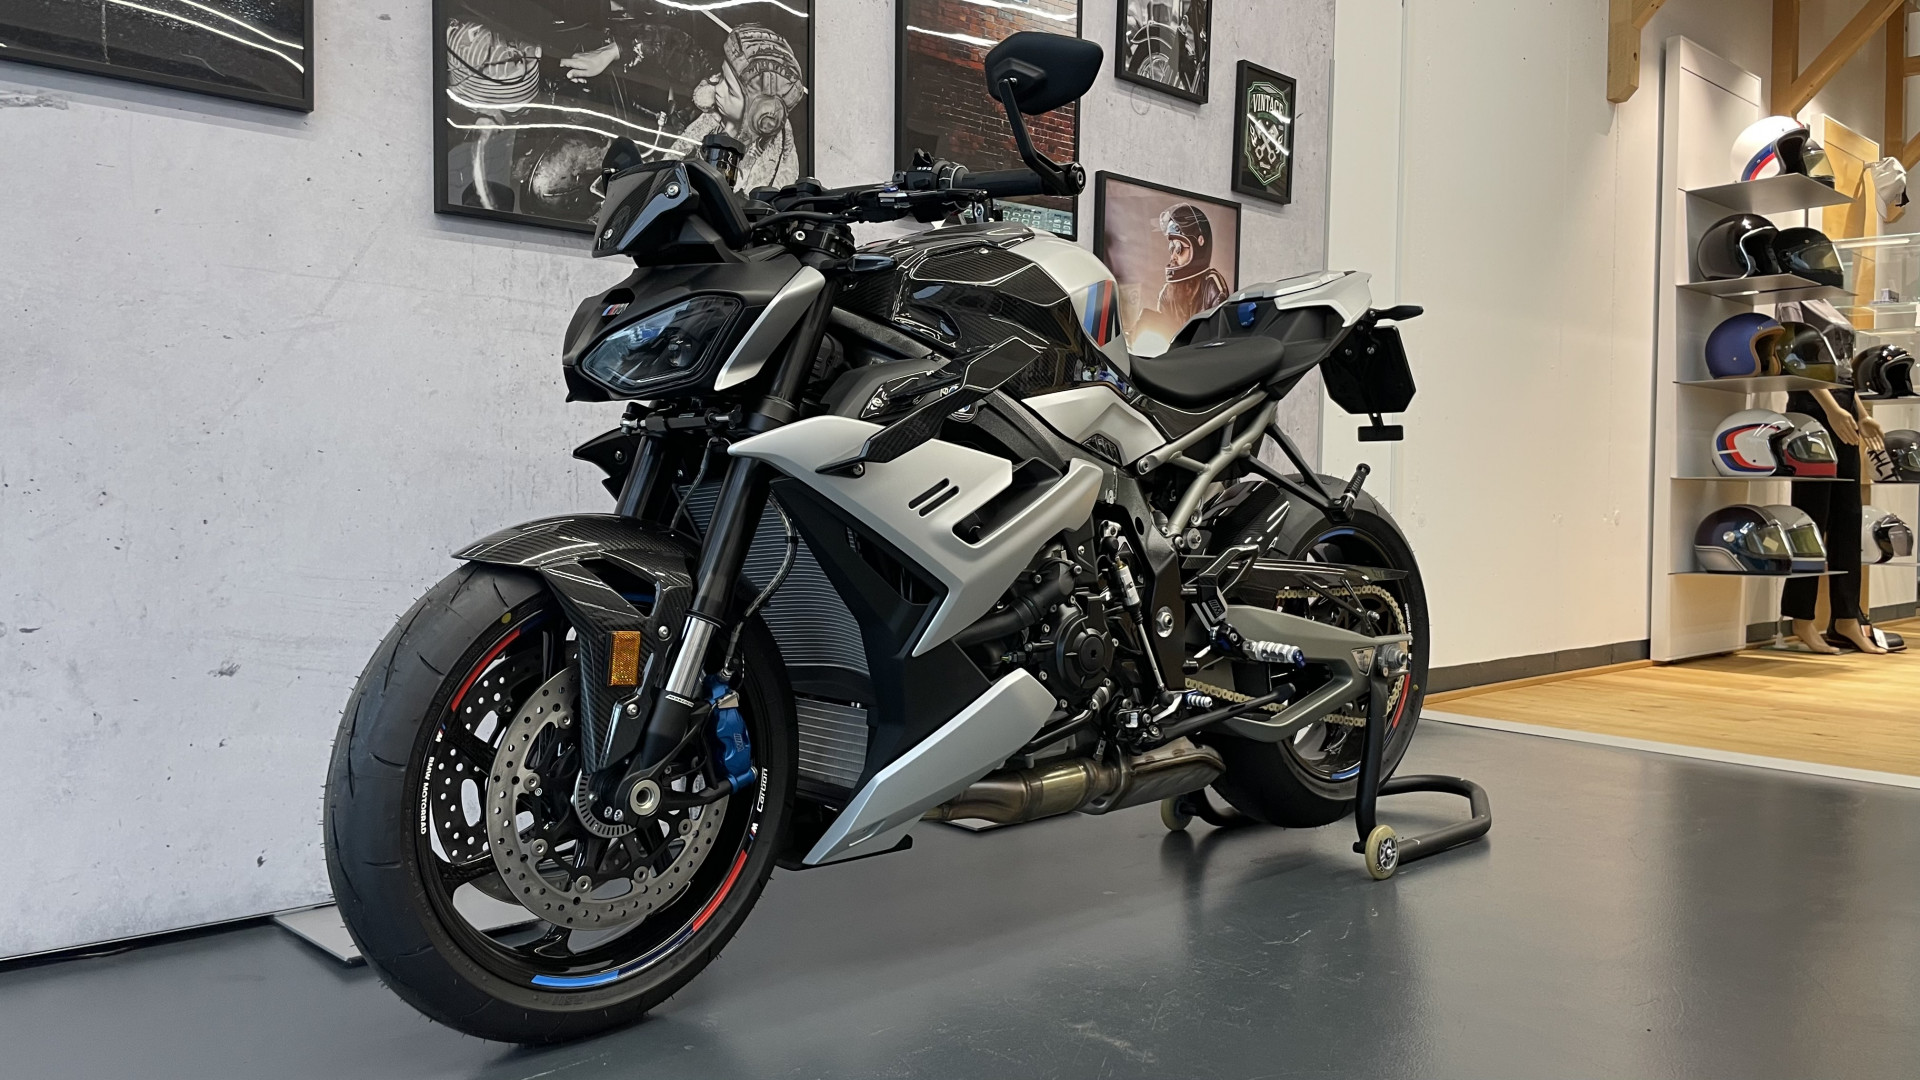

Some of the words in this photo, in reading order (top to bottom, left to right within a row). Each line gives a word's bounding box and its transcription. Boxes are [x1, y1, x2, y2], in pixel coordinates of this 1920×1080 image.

[1253, 94, 1284, 115] VINTAGE
[424, 756, 435, 780] BMW
[757, 767, 768, 813] Carbon
[420, 782, 429, 835] MOTORRAD
